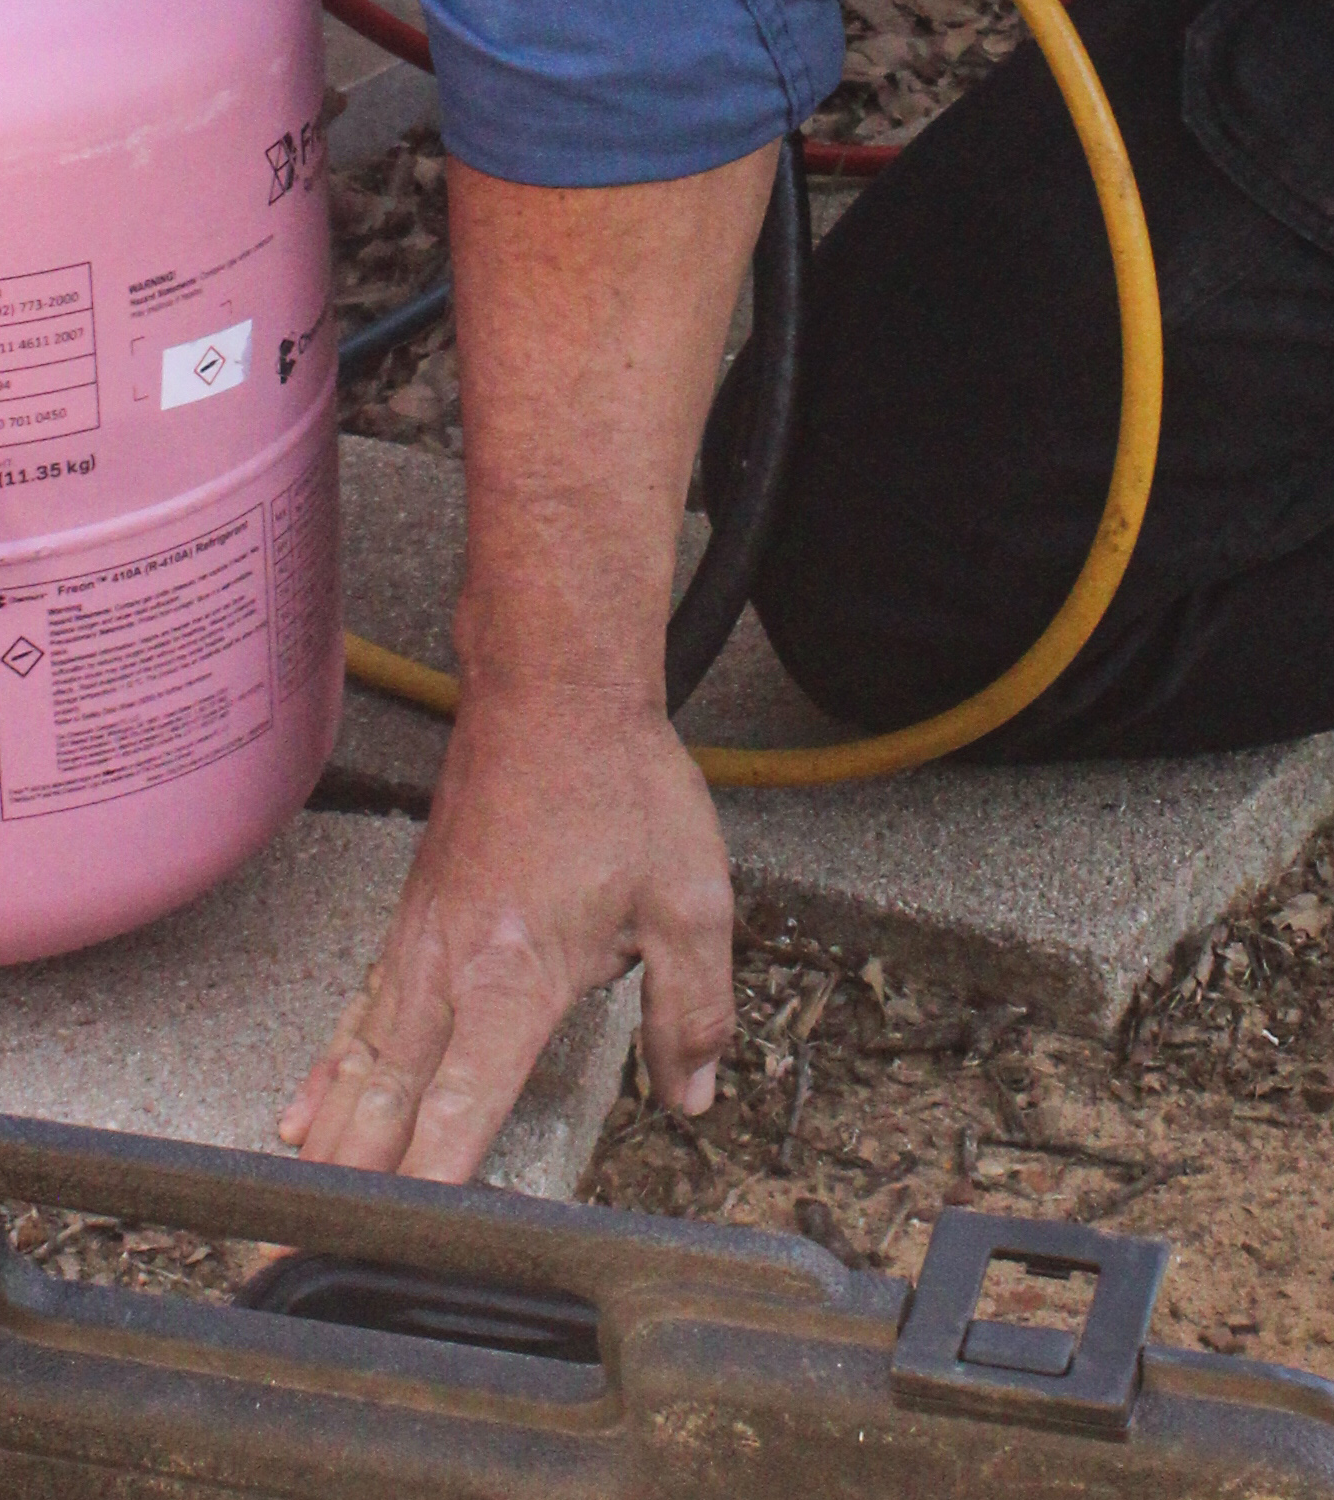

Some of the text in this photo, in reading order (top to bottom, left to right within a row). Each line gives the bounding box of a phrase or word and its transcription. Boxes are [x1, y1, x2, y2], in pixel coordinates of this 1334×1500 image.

[20, 291, 80, 312] 773-2000
[0, 341, 14, 353] 11
[19, 336, 49, 351] 4611
[55, 327, 84, 345] 2007
[9, 415, 31, 428] 701
[35, 407, 67, 423] 0450
[67, 453, 96, 475] kg)
[112, 520, 248, 583] 410A (R-410A) Refrigerant
